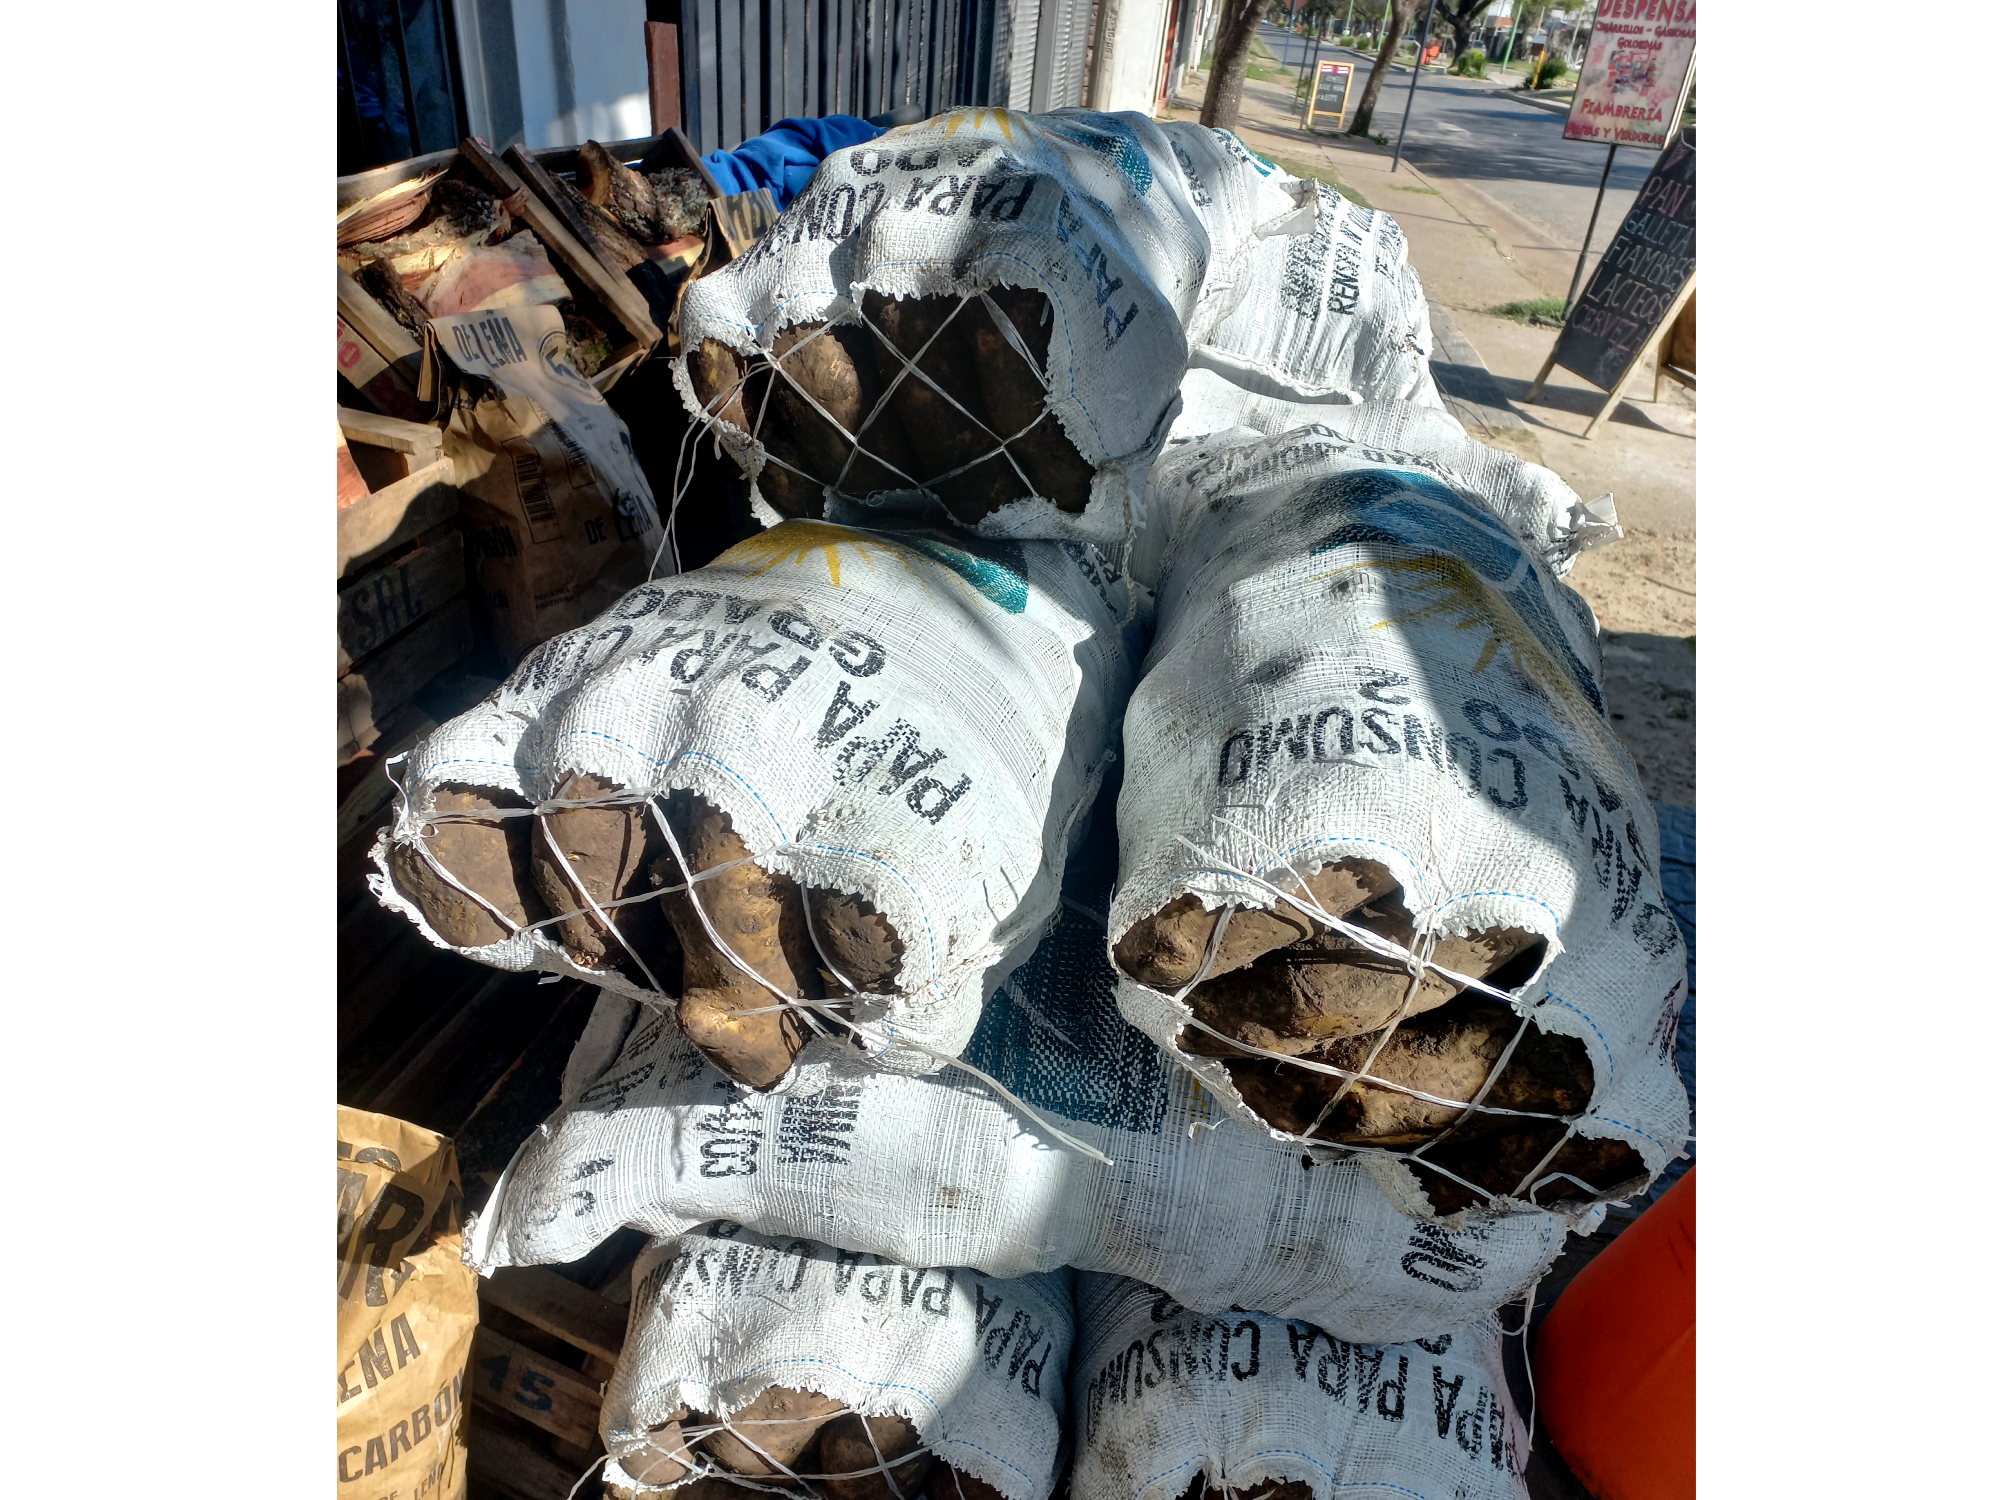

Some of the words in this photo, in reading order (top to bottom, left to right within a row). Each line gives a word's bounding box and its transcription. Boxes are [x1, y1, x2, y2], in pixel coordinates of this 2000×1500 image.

[1597, 0, 1697, 27] DESPENSA
[1639, 176, 1692, 218] PAN
[584, 516, 609, 546] DE
[1216, 707, 1529, 811] CONSUMO
[1286, 1325, 1410, 1424] PARA
